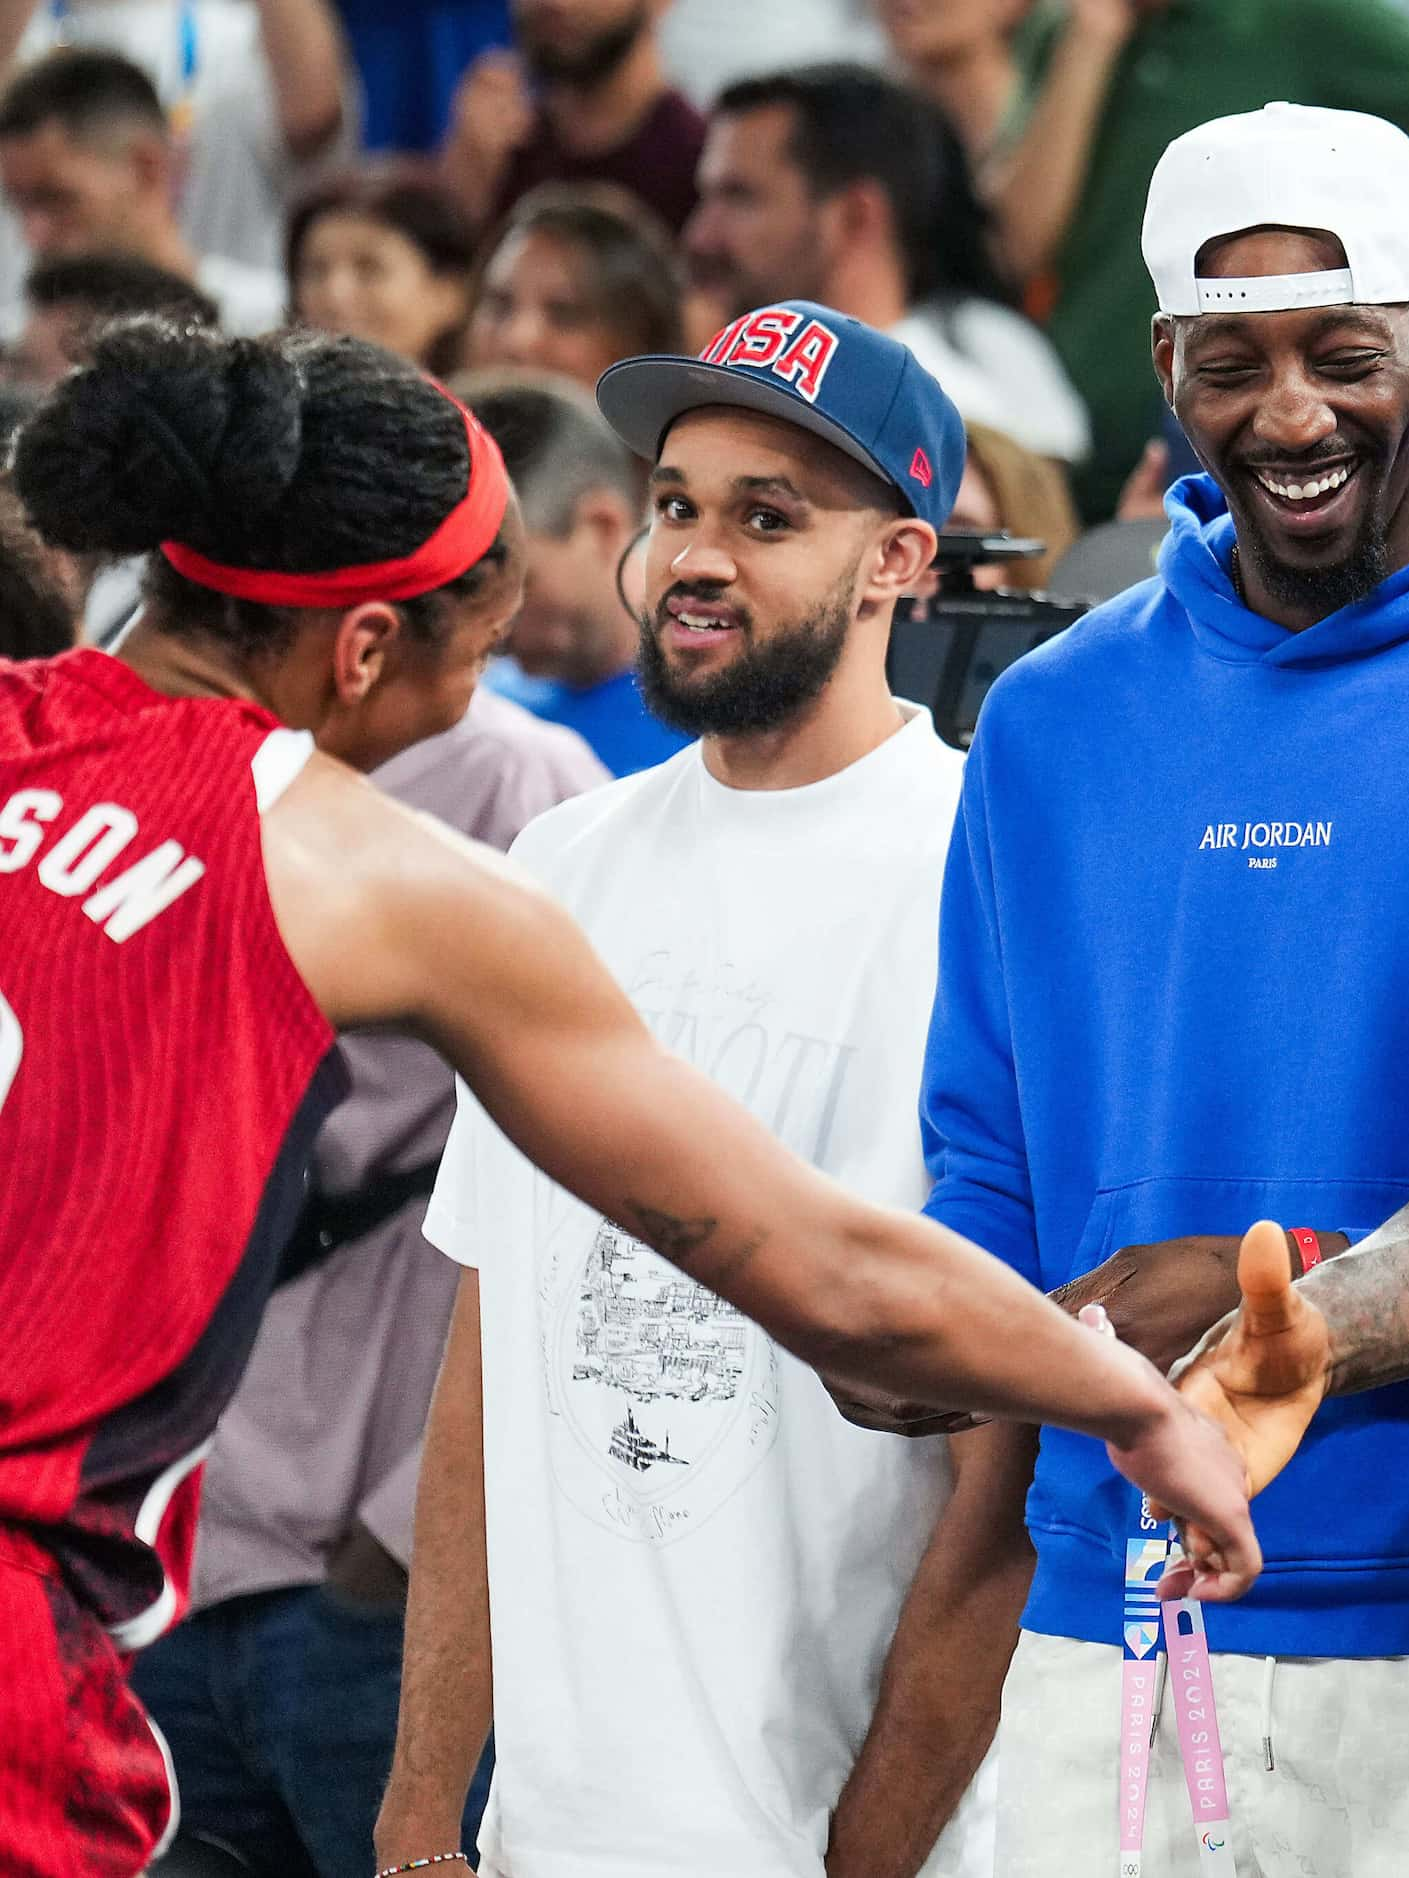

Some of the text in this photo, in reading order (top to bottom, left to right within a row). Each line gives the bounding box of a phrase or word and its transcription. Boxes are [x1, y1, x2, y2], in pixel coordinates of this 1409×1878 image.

[699, 308, 839, 403] USA
[0, 788, 206, 945] SON
[1199, 822, 1333, 850] AIR JORDAN
[1248, 857, 1277, 869] PARIS
[1128, 1676, 1145, 1838] PARIS 2024
[1181, 1649, 1217, 1810] PARIS 2024
